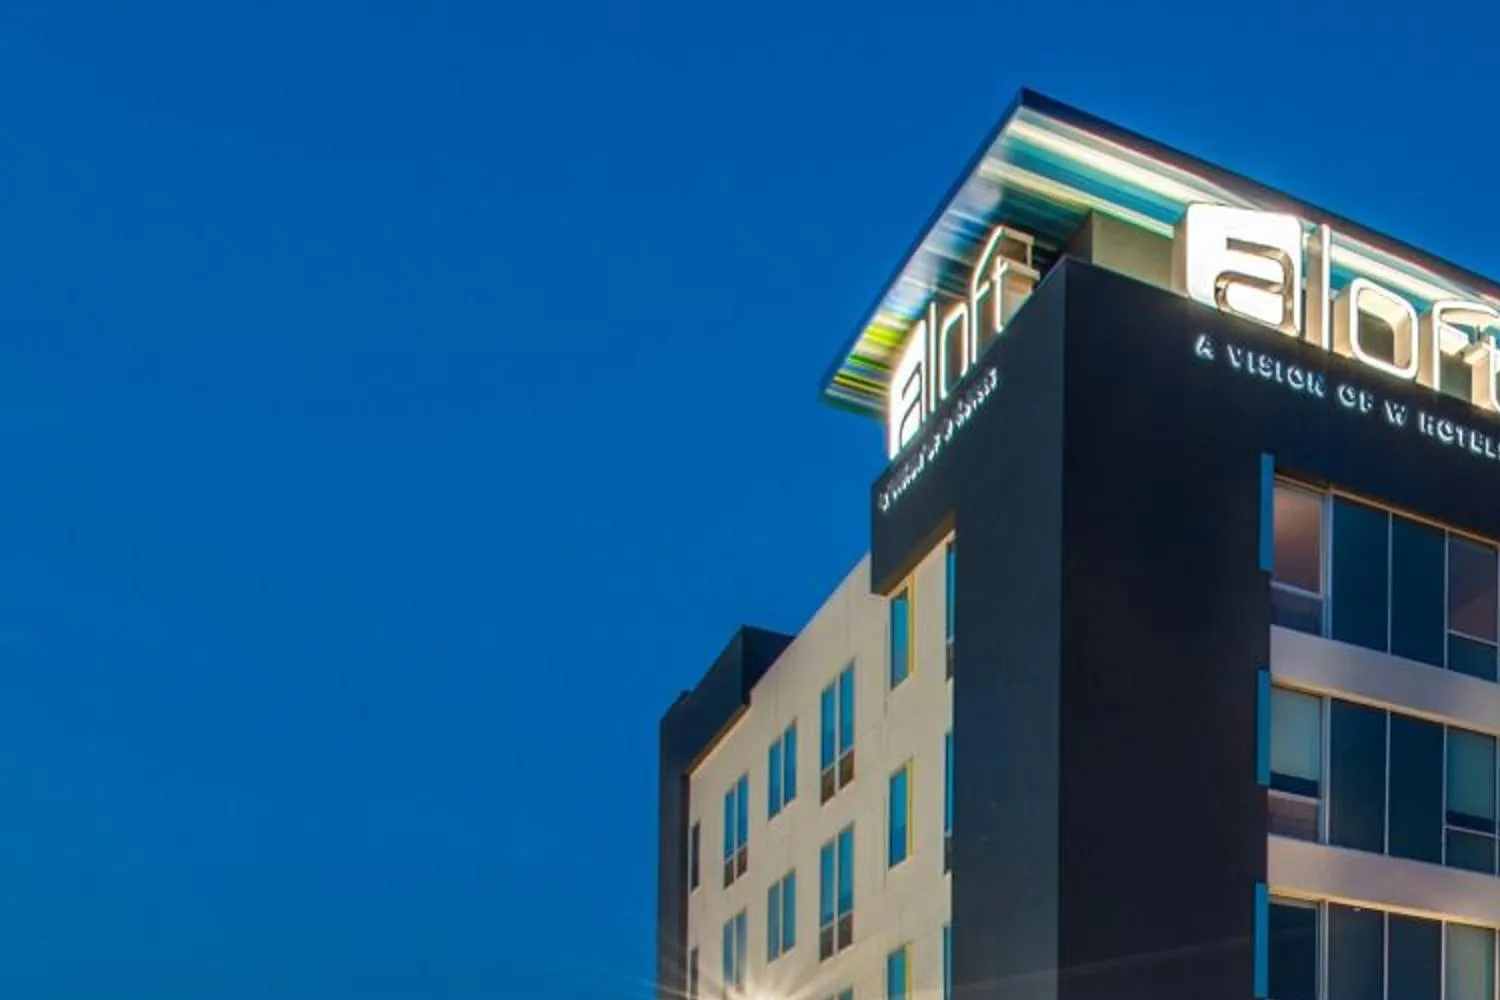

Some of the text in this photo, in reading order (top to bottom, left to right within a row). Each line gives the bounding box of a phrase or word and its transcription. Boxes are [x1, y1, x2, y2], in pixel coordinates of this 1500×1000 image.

[886, 224, 1012, 462] aloft
[1194, 334, 1216, 362] A
[1225, 342, 1327, 399] VISION
[1337, 383, 1374, 414] OF
[1383, 399, 1408, 427] W
